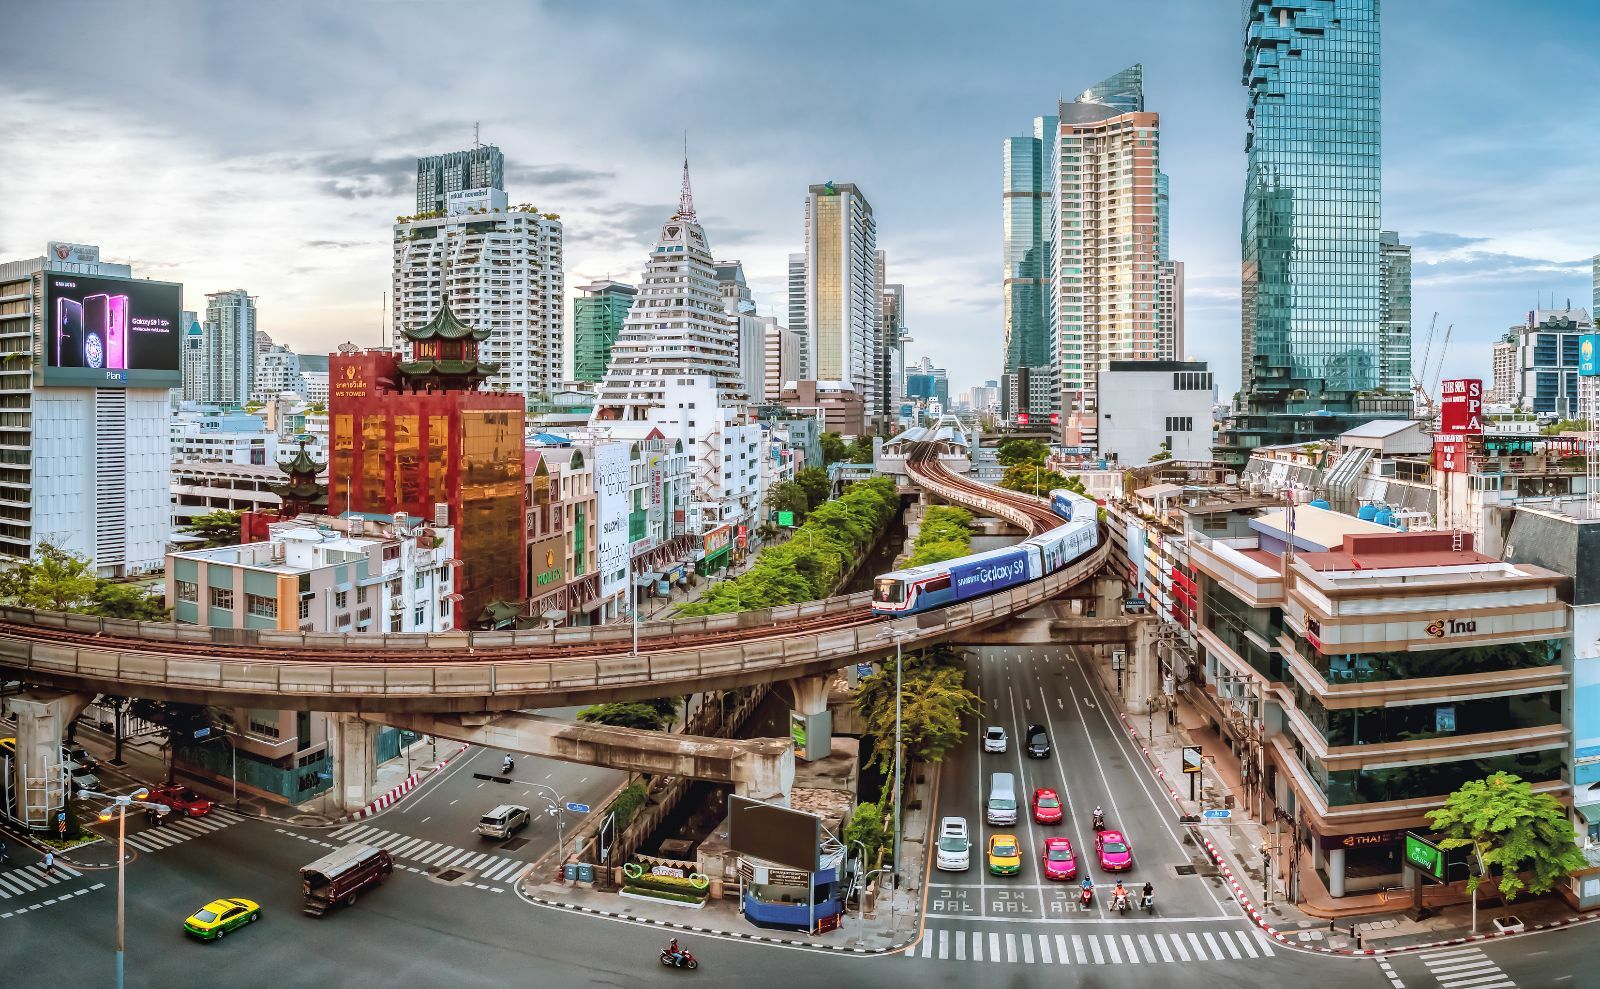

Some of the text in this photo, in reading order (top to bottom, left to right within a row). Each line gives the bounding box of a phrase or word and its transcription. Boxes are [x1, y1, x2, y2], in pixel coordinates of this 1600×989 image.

[132, 318, 150, 326] Galaxy
[106, 371, 121, 380] Plan
[1467, 383, 1481, 430] SPA
[537, 567, 562, 586] ROLEX
[980, 564, 1013, 583] Galaxy
[1014, 559, 1024, 575] S9
[1357, 836, 1381, 844] THAI
[1411, 852, 1432, 870] Chang
